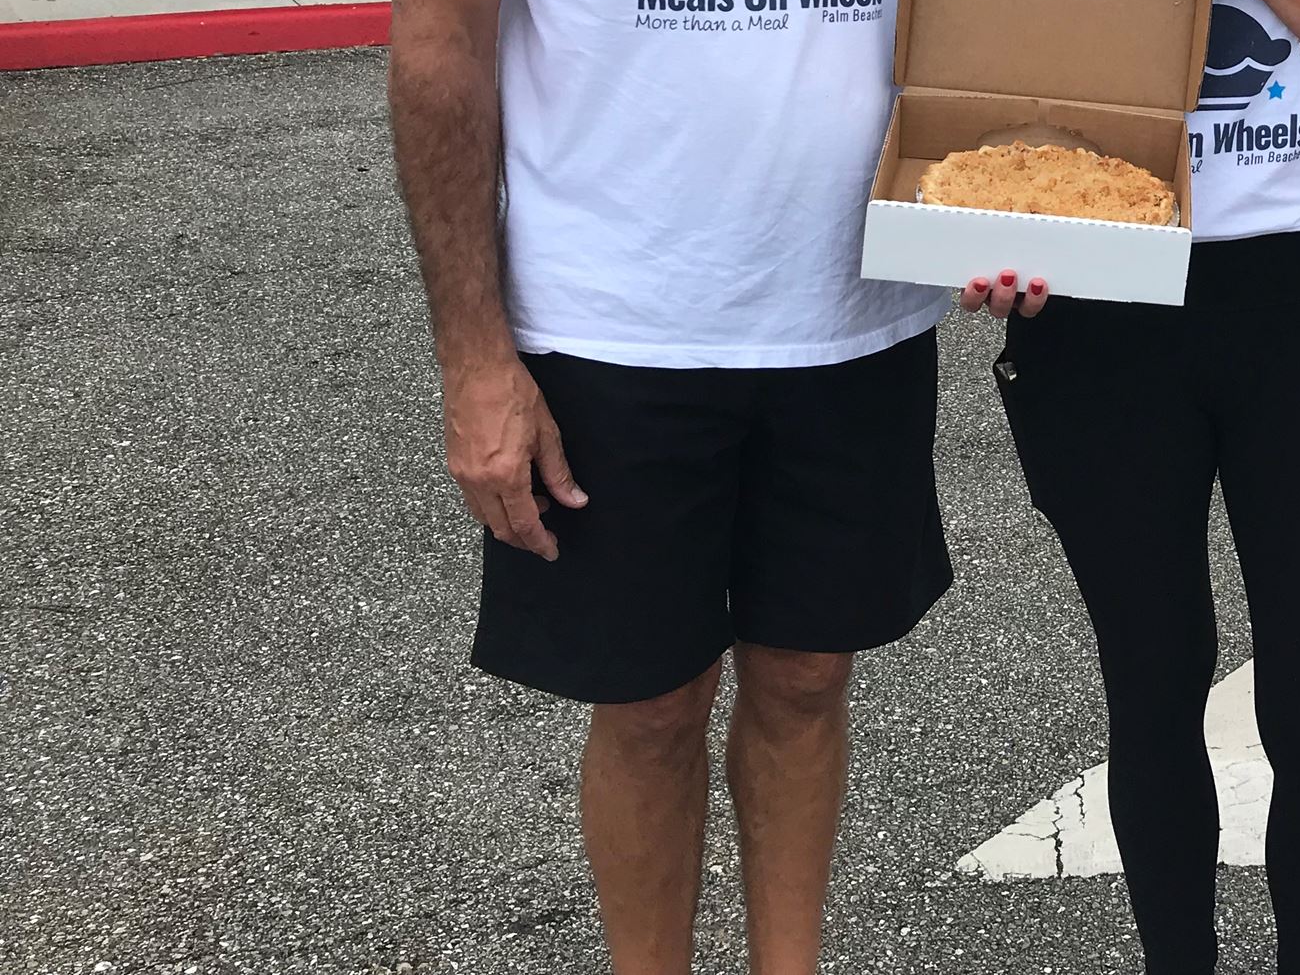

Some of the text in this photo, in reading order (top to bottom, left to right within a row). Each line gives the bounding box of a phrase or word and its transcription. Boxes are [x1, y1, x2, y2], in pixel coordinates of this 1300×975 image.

[635, 13, 789, 31] More than a Meal
[822, 9, 849, 22] Palm
[1189, 132, 1203, 158] n
[1237, 154, 1263, 166] Palm
